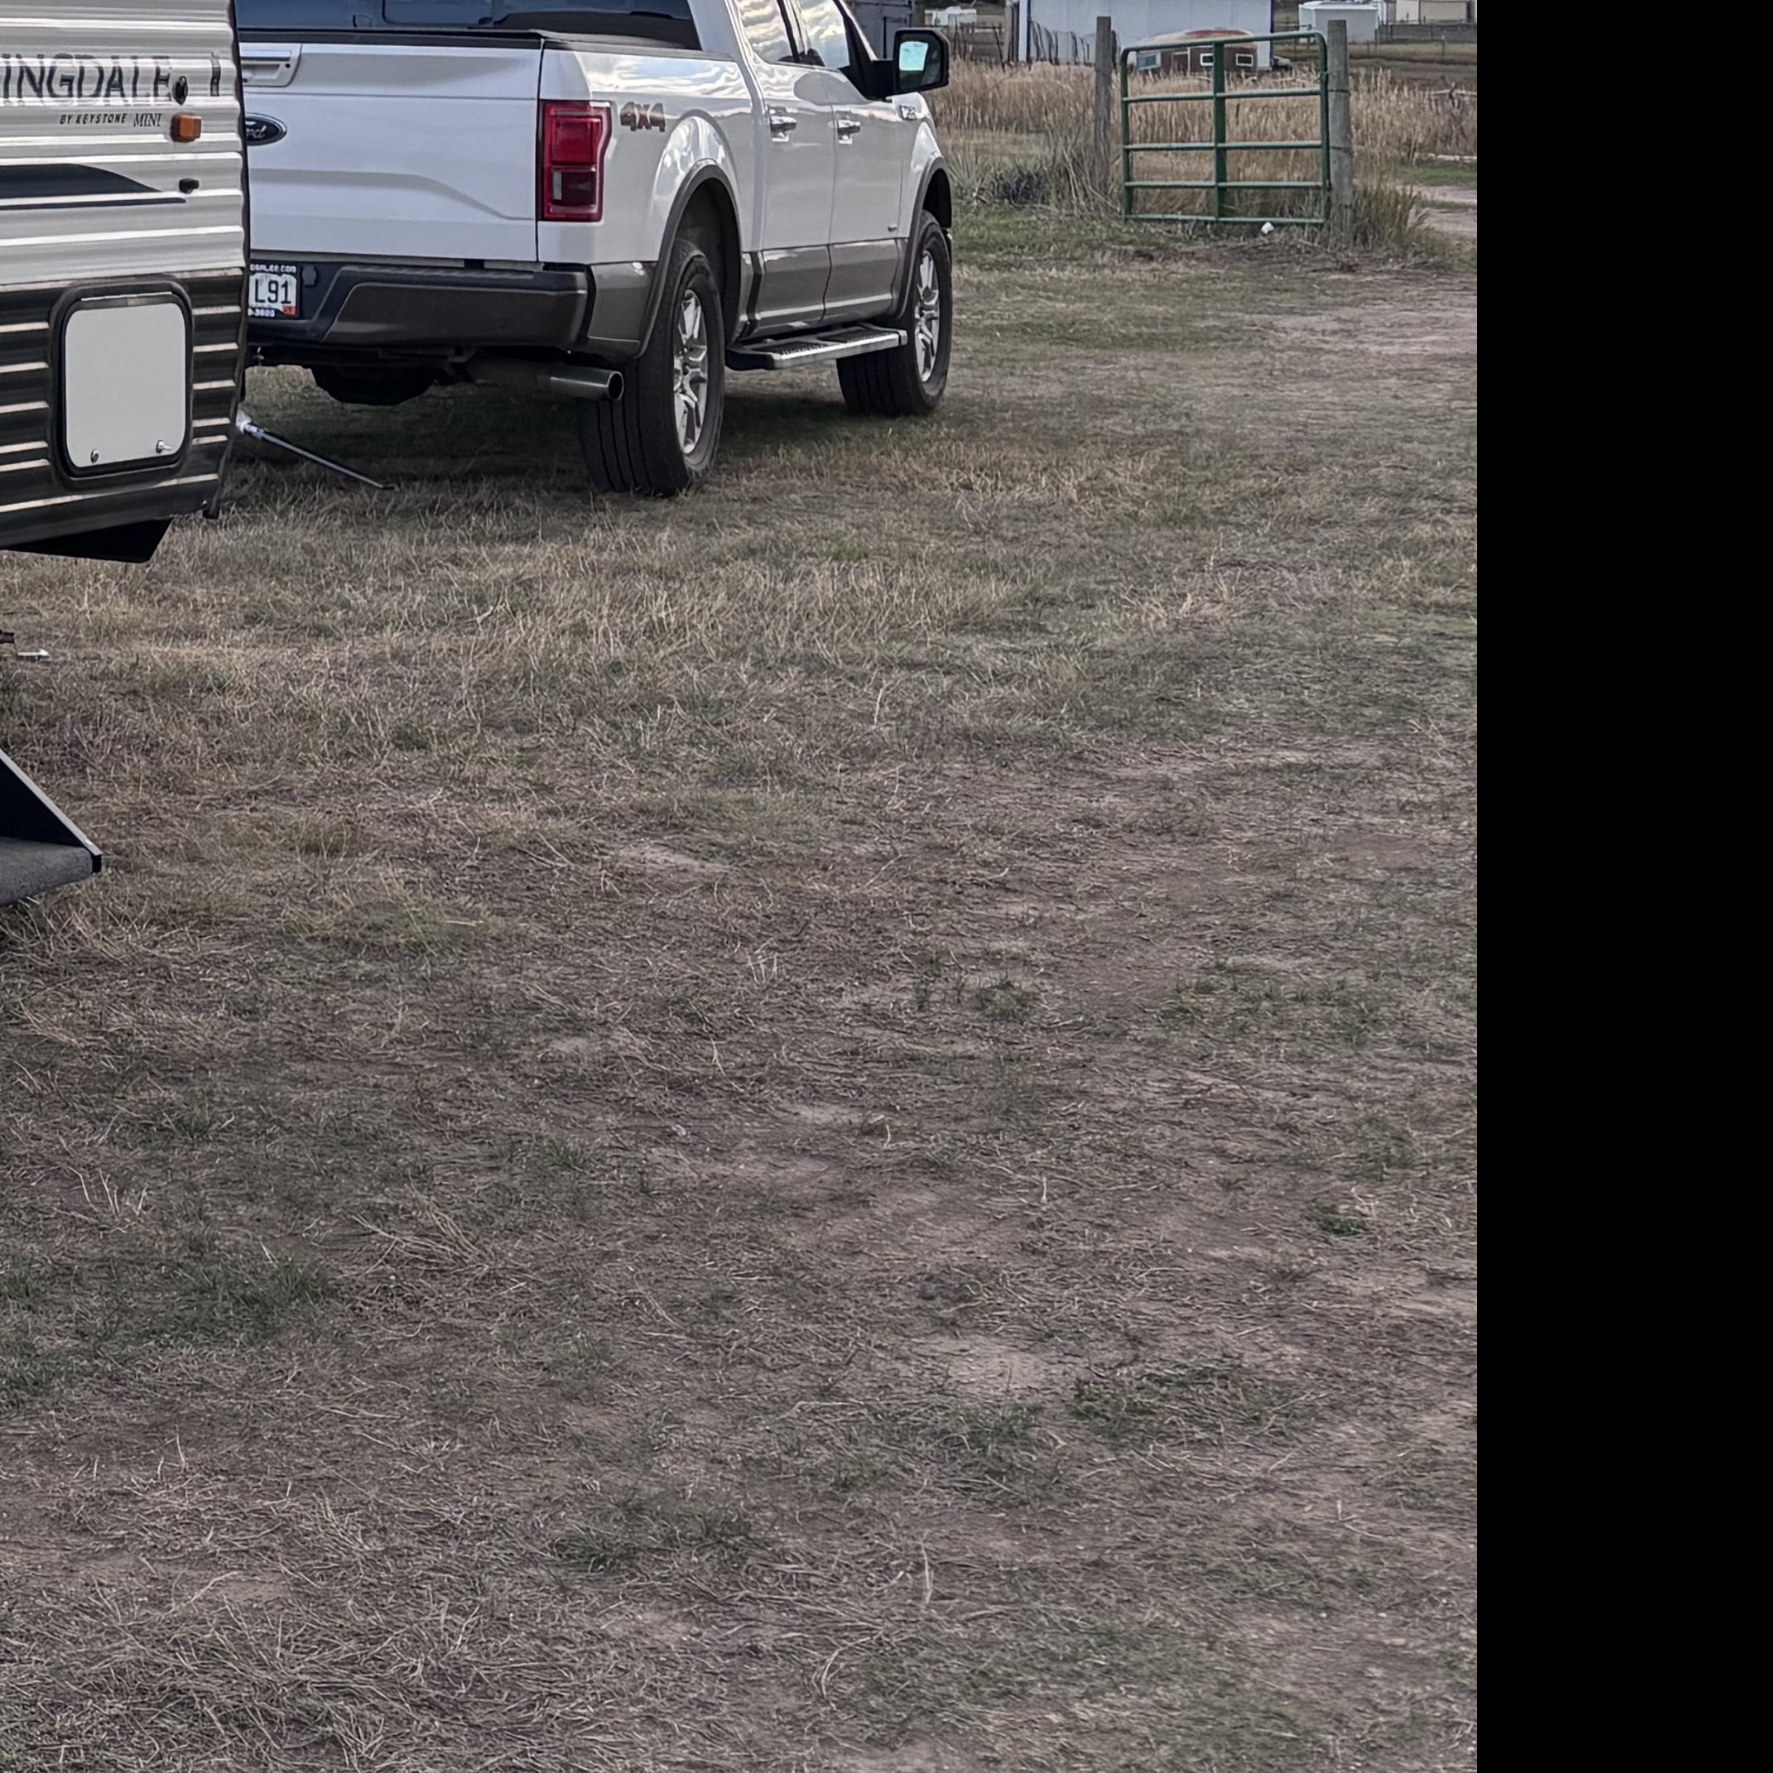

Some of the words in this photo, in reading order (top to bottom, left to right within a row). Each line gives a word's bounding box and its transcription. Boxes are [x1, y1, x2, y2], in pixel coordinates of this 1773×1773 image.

[59, 114, 73, 125] BY
[75, 112, 128, 125] KEYSTONE
[133, 112, 162, 127] MINI
